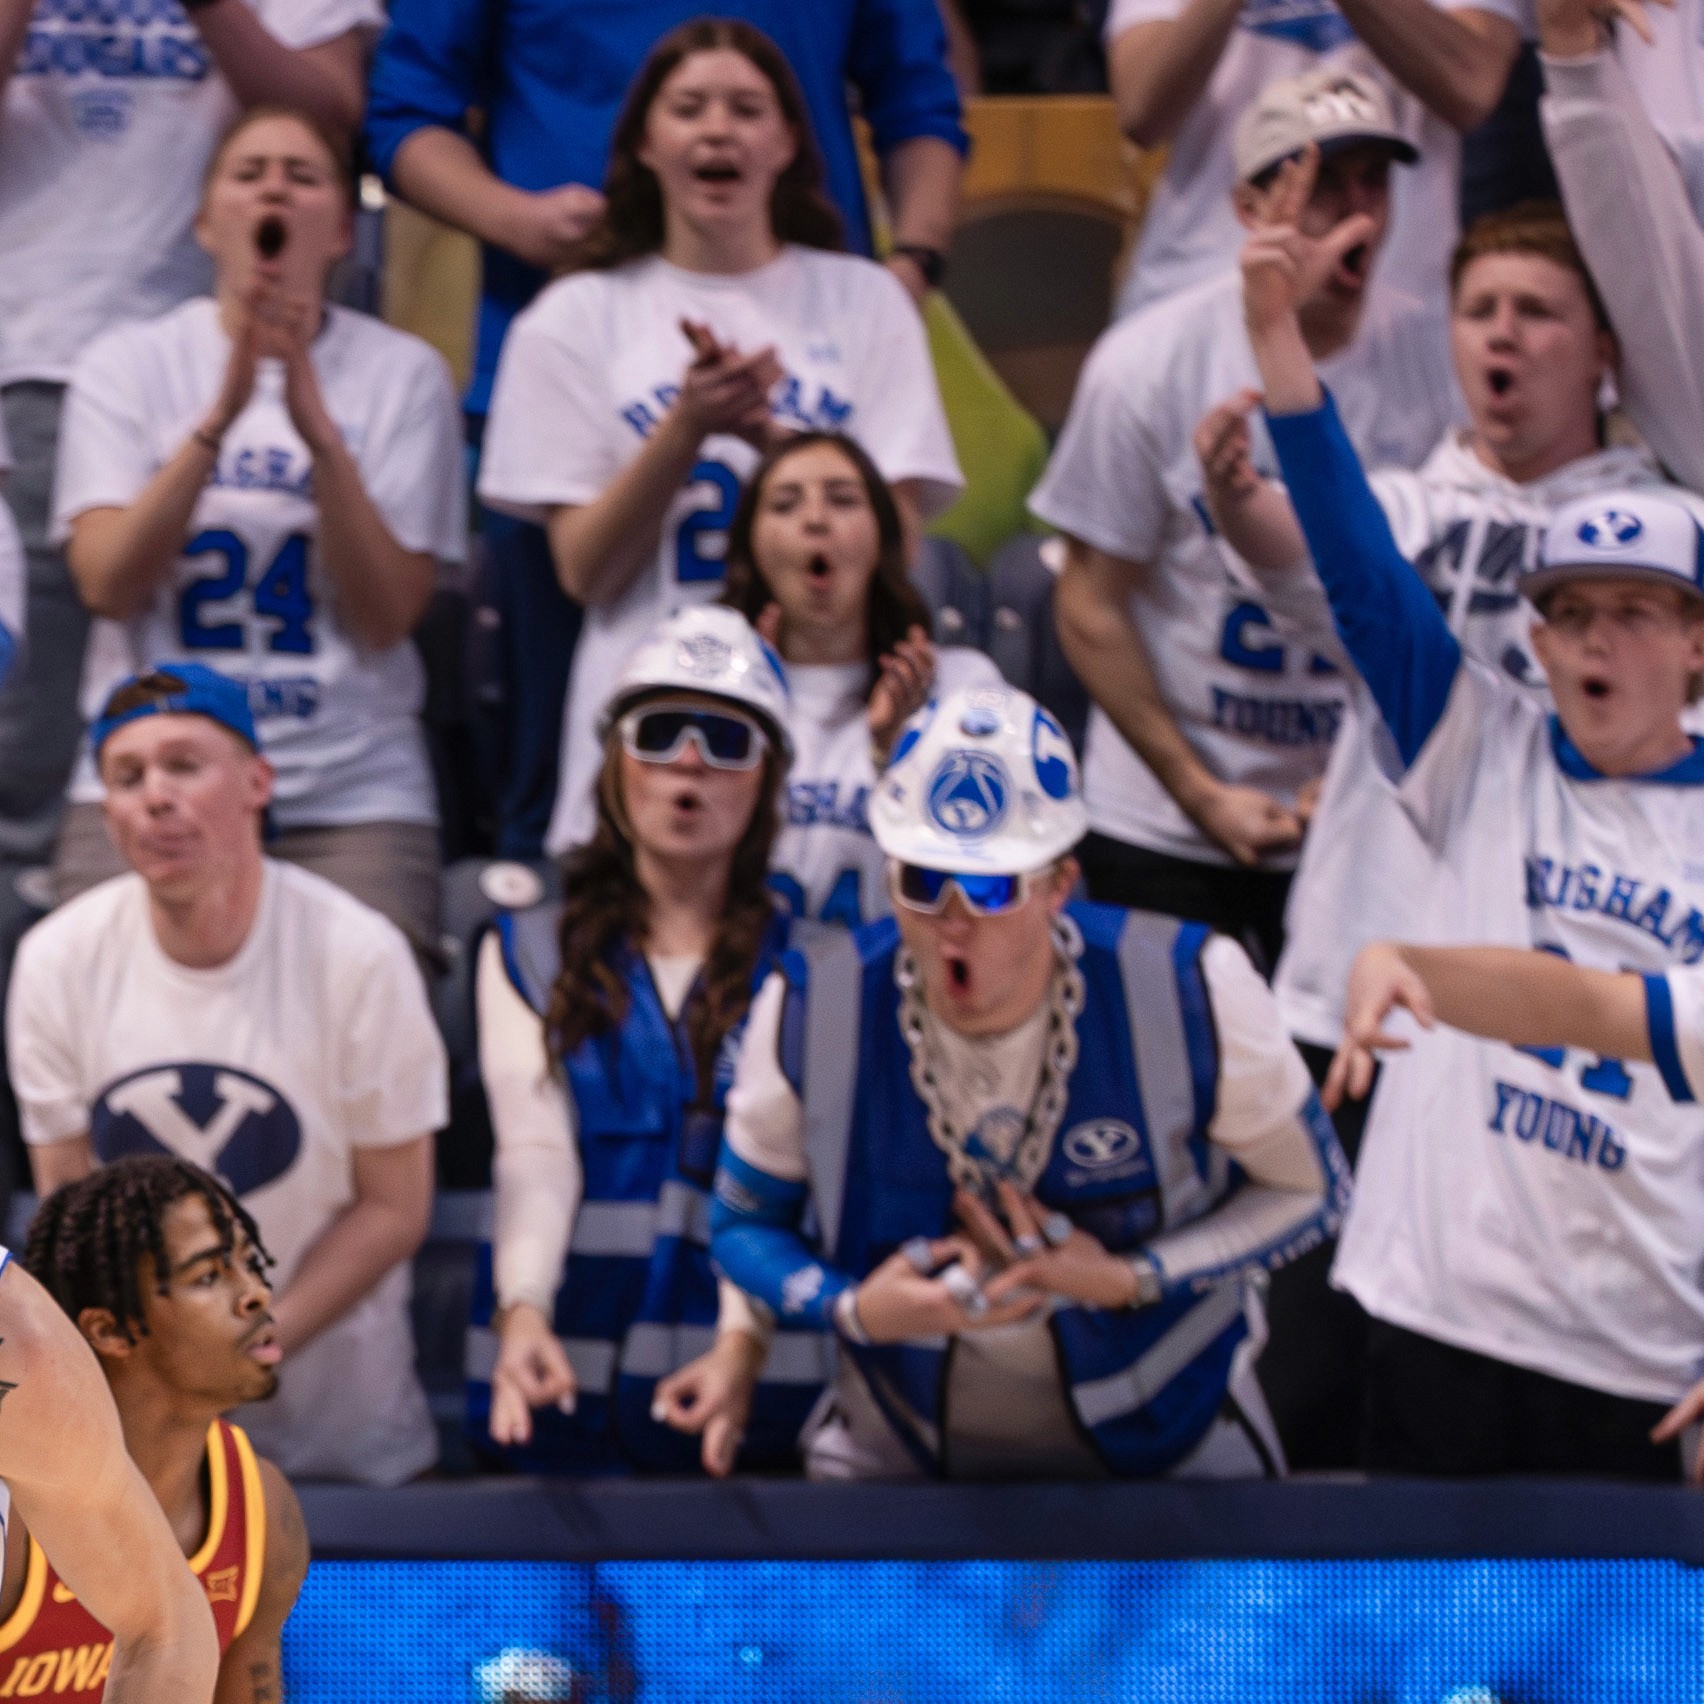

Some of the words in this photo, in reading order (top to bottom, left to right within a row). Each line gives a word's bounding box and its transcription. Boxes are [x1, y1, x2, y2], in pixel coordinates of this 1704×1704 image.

[180, 530, 313, 654] 24
[104, 1069, 277, 1195] Y
[1488, 1078, 1626, 1171] YOUNG
